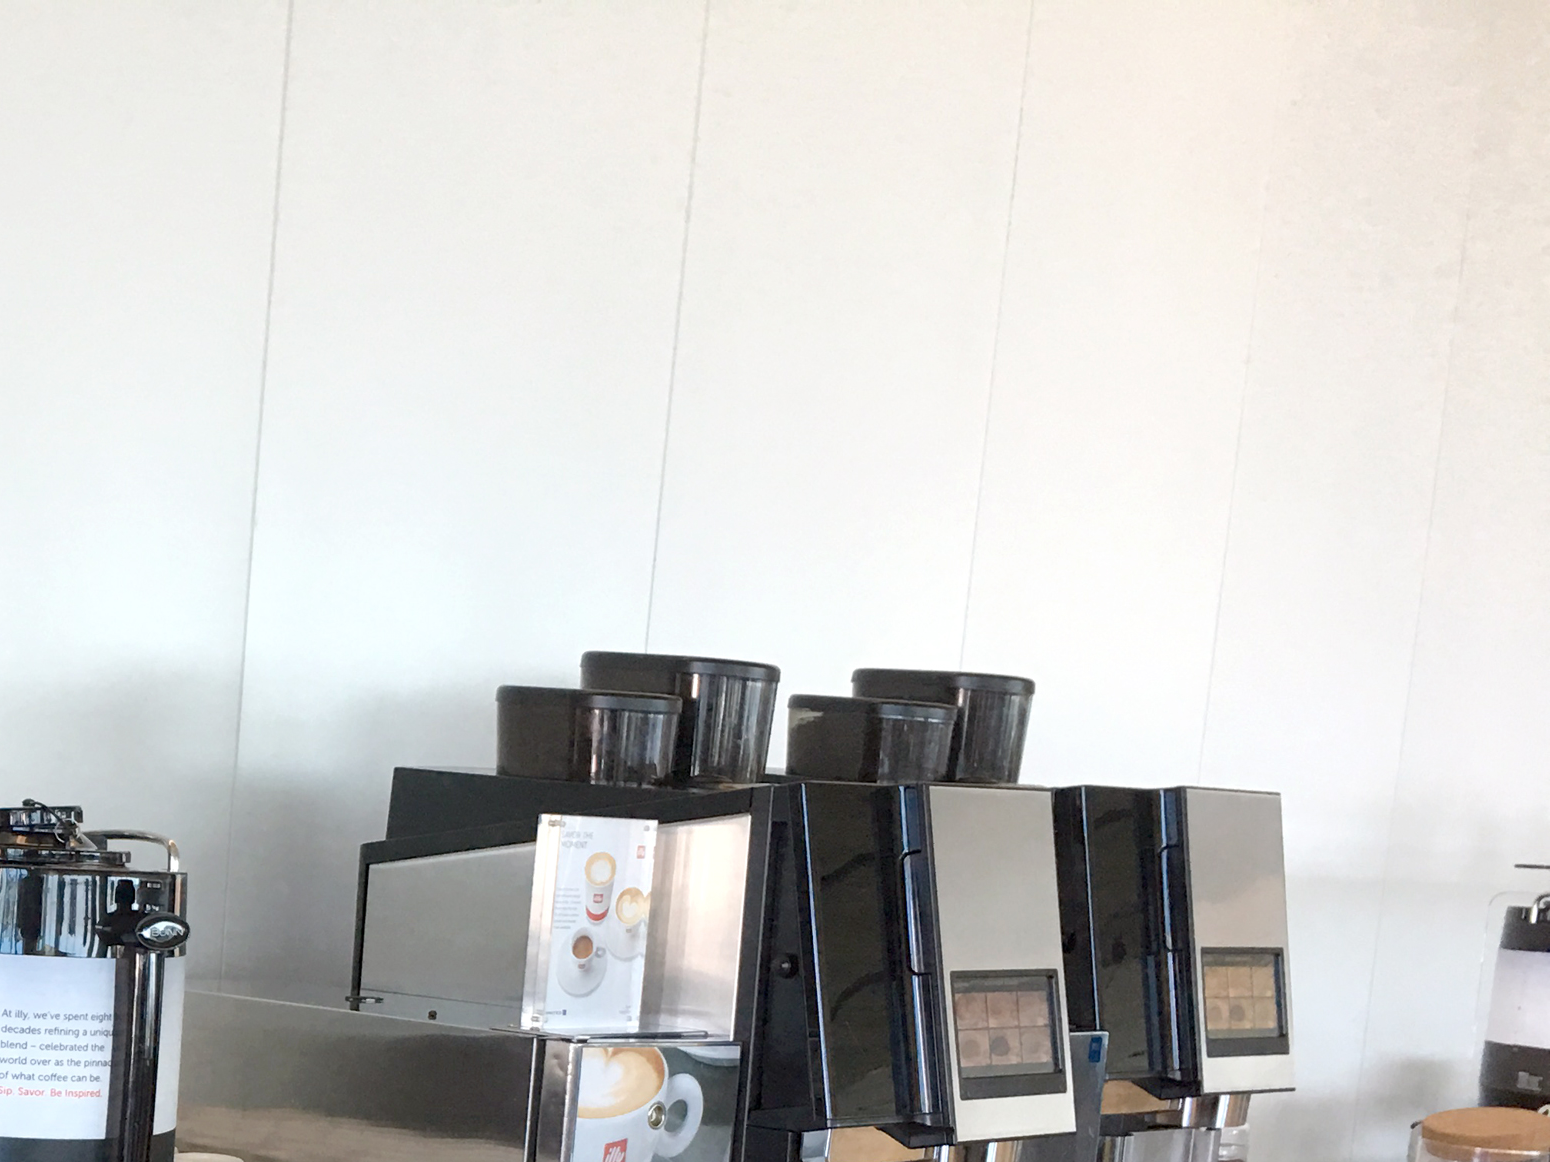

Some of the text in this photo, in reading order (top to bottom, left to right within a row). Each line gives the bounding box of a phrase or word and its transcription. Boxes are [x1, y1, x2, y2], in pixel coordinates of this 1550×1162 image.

[1, 1009, 112, 1023] At illy, we've spent eight
[1, 1025, 41, 1035] decades
[44, 1027, 80, 1038] refining
[0, 1040, 28, 1049] blend
[39, 1042, 88, 1052] celebrated
[91, 1043, 105, 1052] the
[0, 1056, 27, 1065] world
[30, 1058, 51, 1066] over
[54, 1059, 64, 1067] as
[66, 1058, 81, 1067] the
[11, 1071, 35, 1081] what
[38, 1073, 68, 1082] coffee
[70, 1075, 87, 1083] can
[50, 1088, 62, 1097] Be
[65, 1089, 103, 1099] Inspired.
